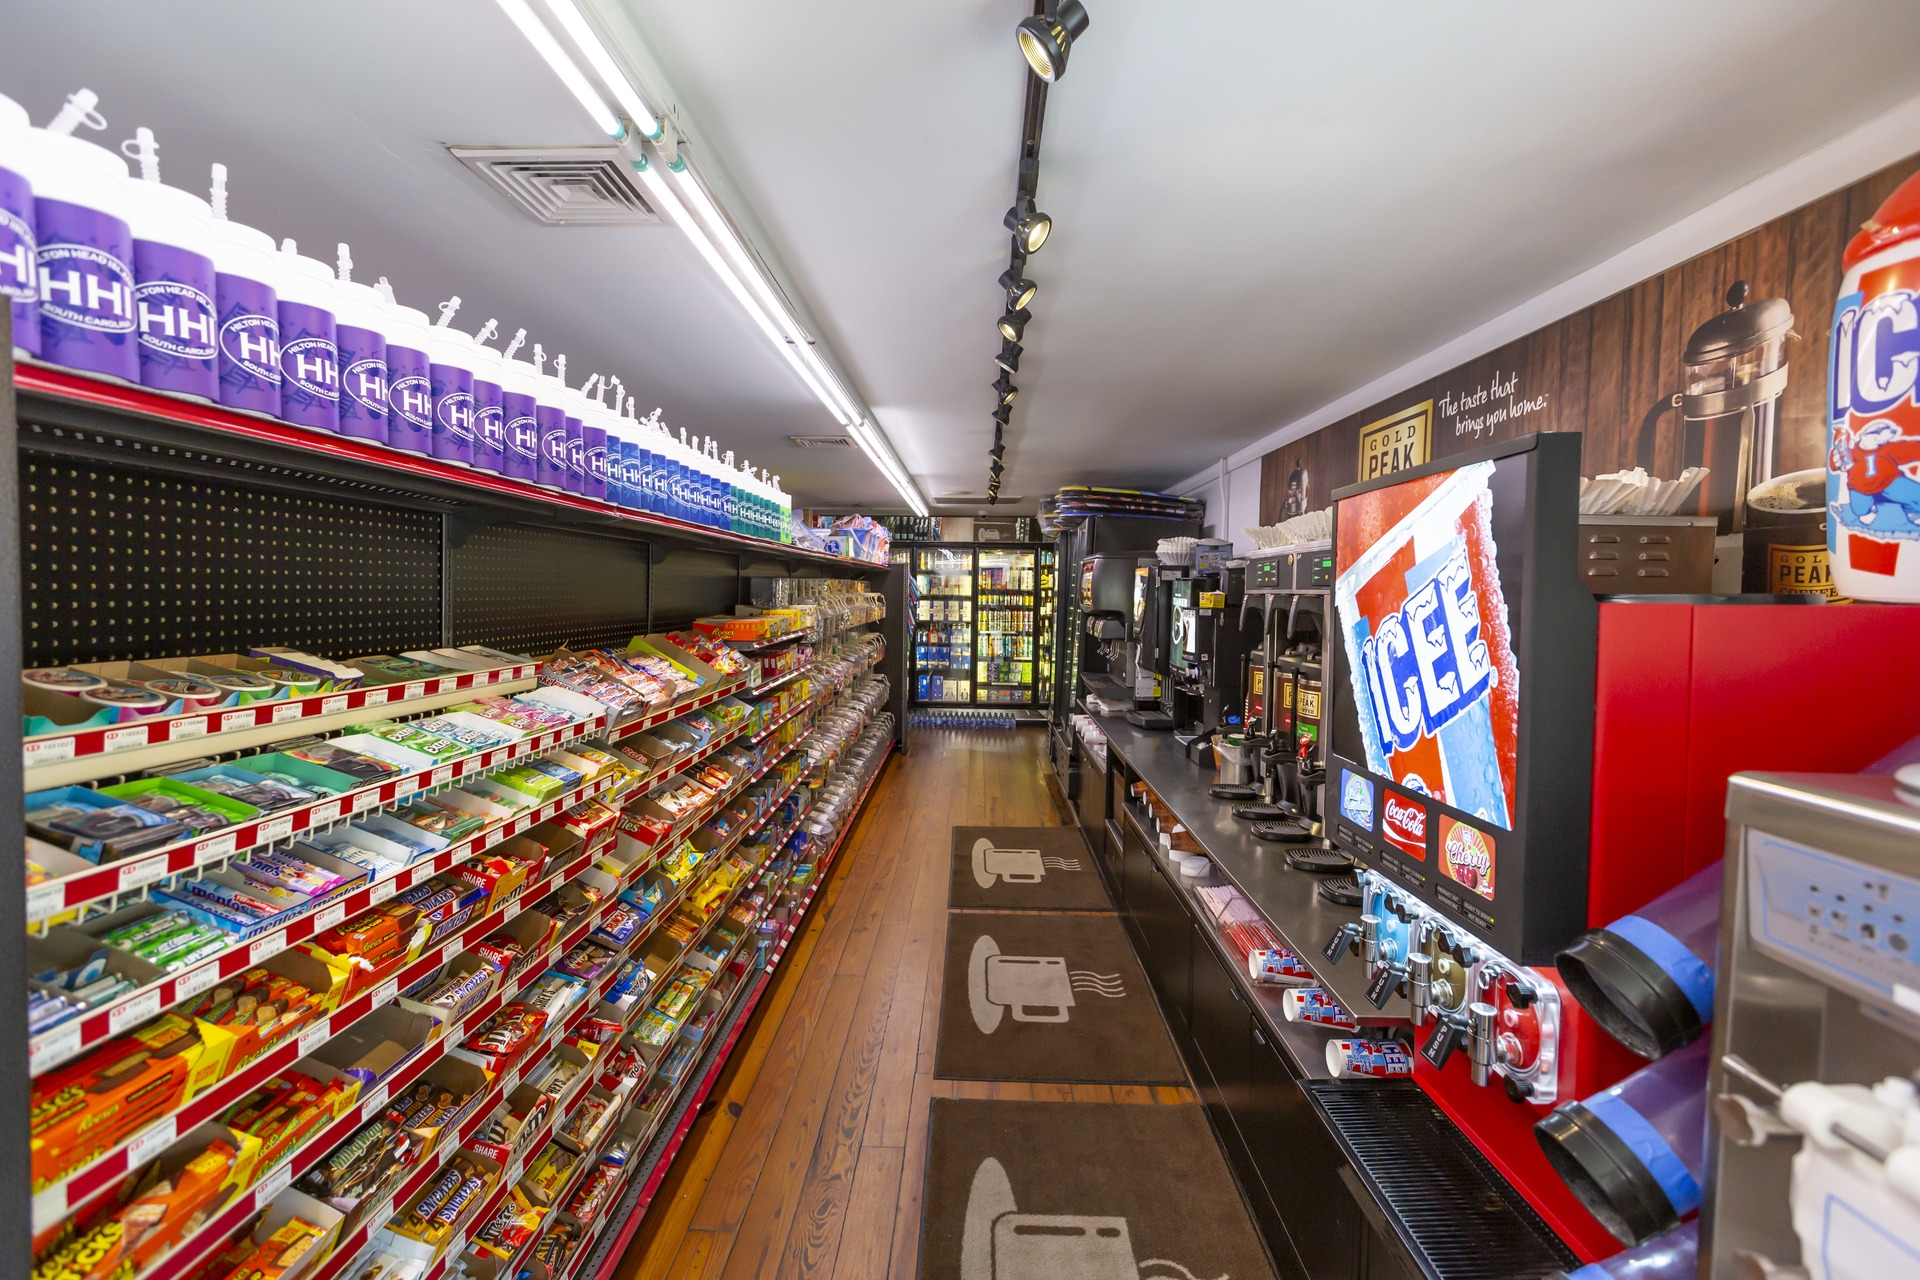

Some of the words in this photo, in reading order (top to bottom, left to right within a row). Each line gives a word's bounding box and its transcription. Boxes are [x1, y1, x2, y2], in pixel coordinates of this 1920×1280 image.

[38, 266, 133, 320] HHI
[165, 287, 195, 299] HEAD
[42, 303, 85, 322] SOUTH
[138, 301, 216, 347] HHI
[230, 318, 261, 332] HILTON
[142, 333, 177, 351] SOUTH
[287, 341, 317, 355] HILTON
[243, 360, 270, 377] SOUTH
[353, 362, 375, 374] HILTON
[300, 379, 324, 395] SOUTH
[396, 379, 418, 390] HILTON
[361, 396, 380, 410] SOUTH
[444, 395, 464, 405] HILTON
[1439, 391, 1458, 419] The
[1460, 385, 1488, 411] taste
[1490, 371, 1519, 399] that
[404, 411, 423, 425] SOUTH
[1456, 415, 1483, 439] brings
[1487, 409, 1507, 437] you
[1370, 425, 1416, 451] GOLD
[1369, 442, 1415, 480] PEAK
[1361, 548, 1491, 758] ICEE
[386, 728, 418, 742] Extra
[457, 730, 484, 743] Extra
[423, 739, 453, 754] Extra
[622, 746, 648, 764] Rolo
[1446, 841, 1490, 877] Cherry
[461, 872, 487, 889] SHARE
[191, 886, 251, 915] mentos
[247, 907, 306, 939] mentos
[1326, 931, 1343, 956] PUSH
[478, 947, 504, 964] SHARE
[453, 969, 489, 1000] SNICKERS
[1370, 971, 1388, 1001] PUSH
[580, 1045, 595, 1053] KING
[1427, 1025, 1448, 1058] PUSH
[473, 1144, 499, 1160] SHARE
[418, 1170, 461, 1216] SNICKERS
[438, 1177, 481, 1221] SNICKERS
[408, 1213, 424, 1229] 4
[428, 1218, 445, 1232] 4
